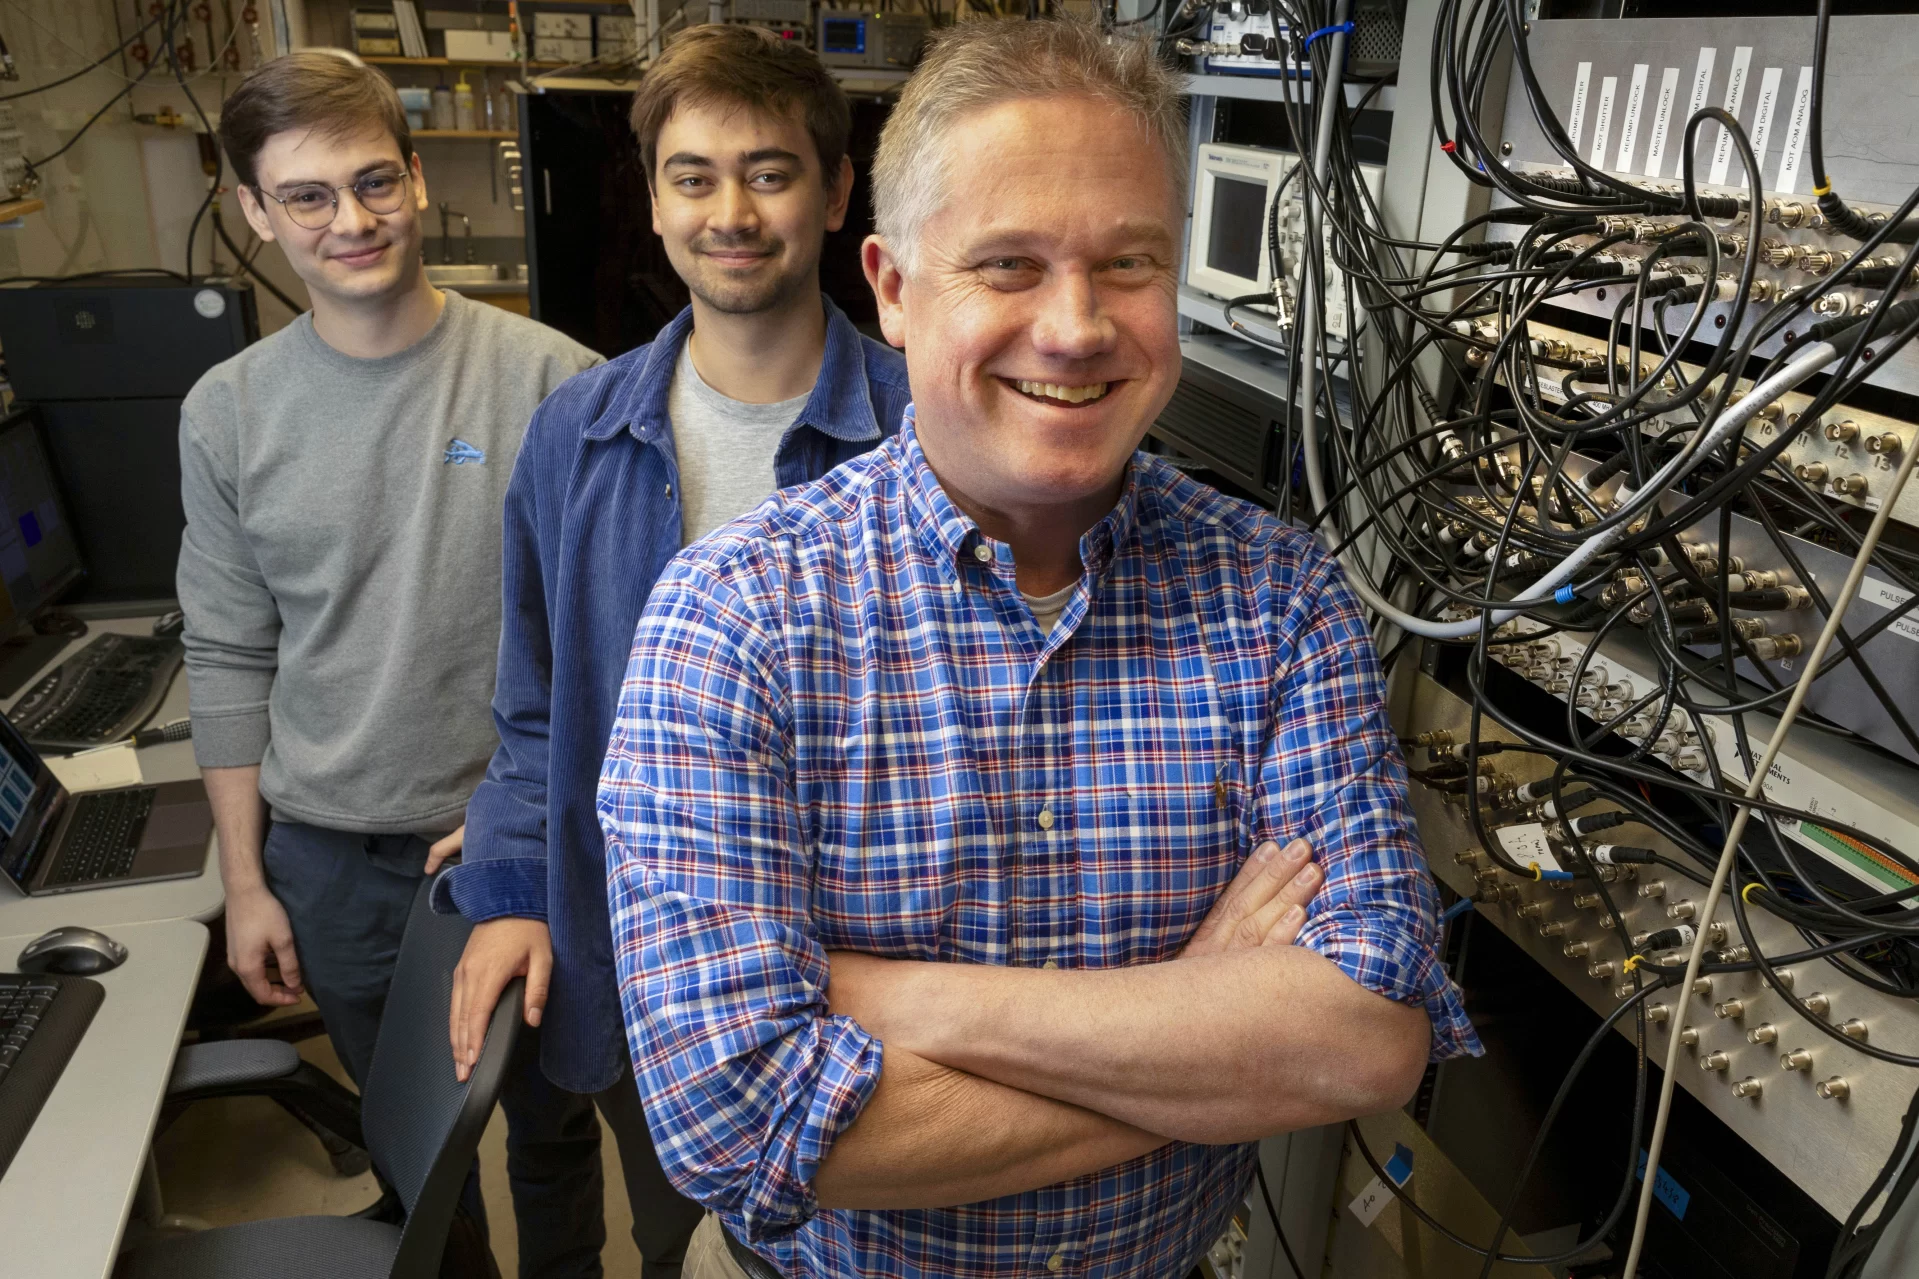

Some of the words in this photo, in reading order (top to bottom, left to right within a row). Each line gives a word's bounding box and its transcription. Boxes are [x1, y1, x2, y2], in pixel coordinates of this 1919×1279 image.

[1576, 81, 1584, 116] SHUTTER
[1696, 69, 1707, 101] DIGITAL
[1732, 68, 1742, 104] ANALOG
[1600, 96, 1609, 132] SHUTTER
[1624, 120, 1634, 153] REPUMP
[1631, 84, 1640, 118] UNLOCK
[1653, 123, 1663, 157] MASTER
[1660, 88, 1670, 122] UNLOCK
[1756, 126, 1764, 146] AOM
[1760, 90, 1772, 124] DIGITAL
[1786, 152, 1795, 171] MOT
[1791, 128, 1800, 149] AOM
[1796, 89, 1809, 126] ANALOG
[1759, 422, 1773, 436] 10
[1797, 433, 1808, 448] 11
[1834, 444, 1850, 460] 12
[1874, 455, 1892, 472] 13
[1880, 590, 1906, 606] PULSE
